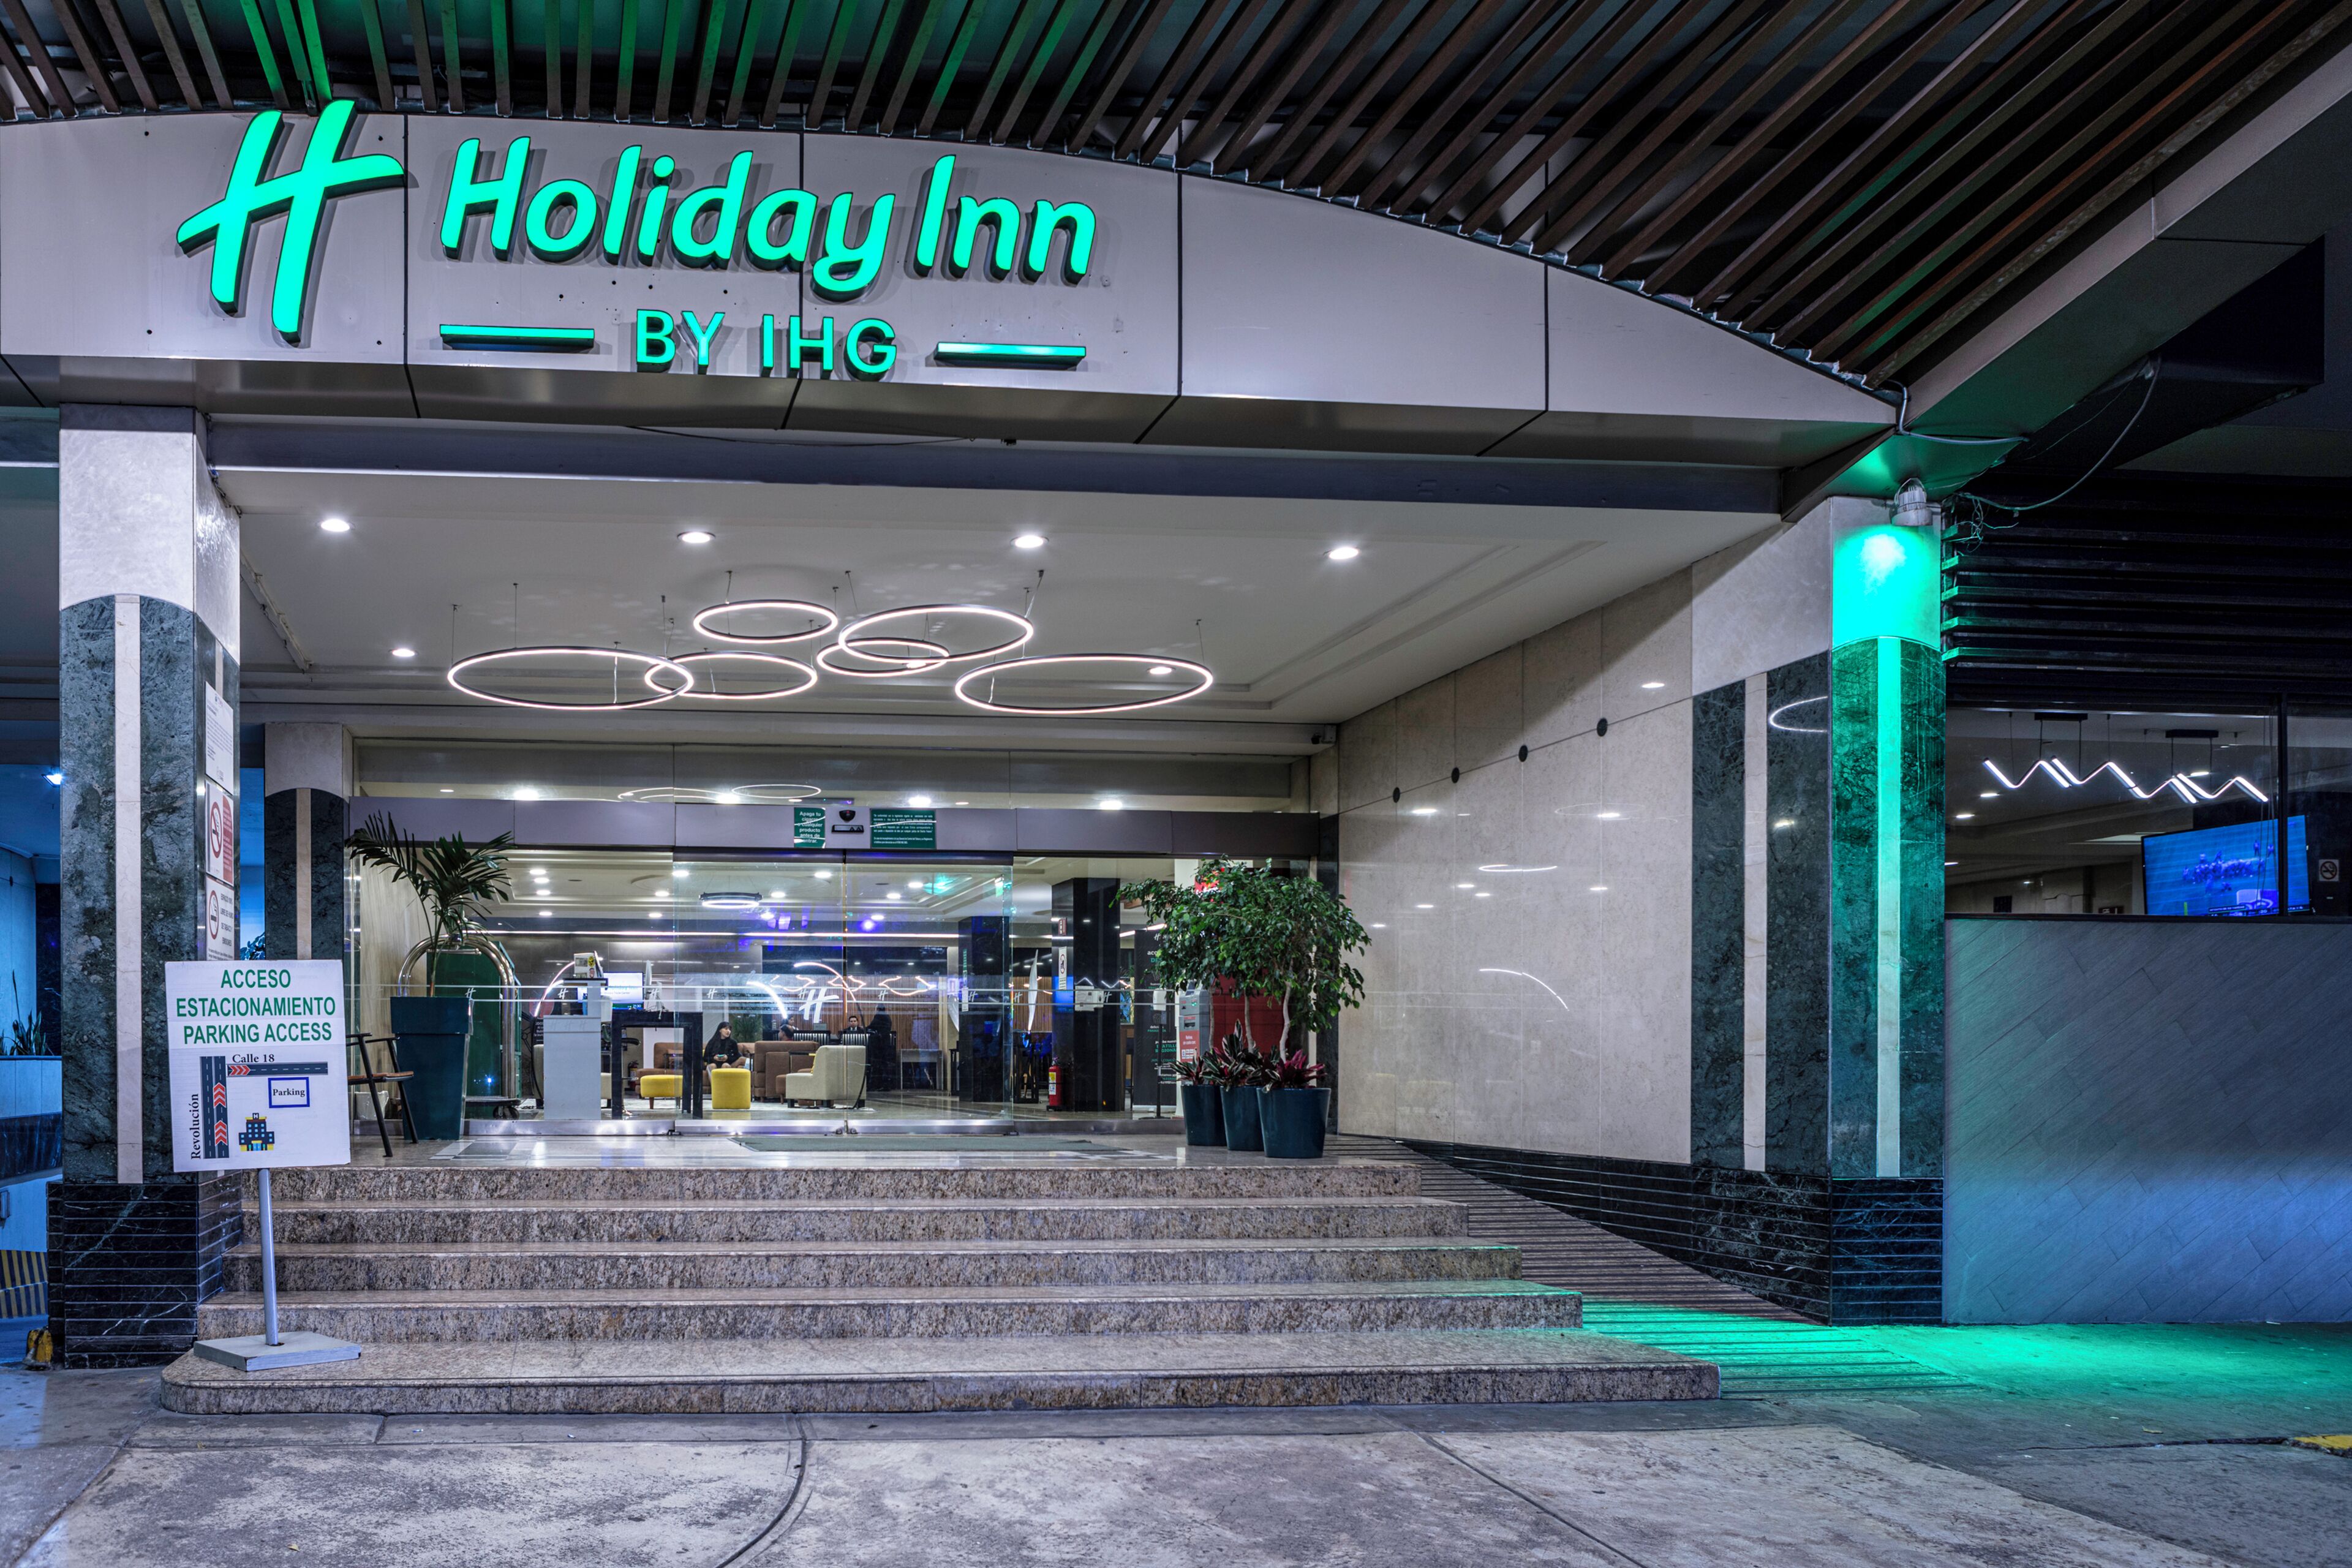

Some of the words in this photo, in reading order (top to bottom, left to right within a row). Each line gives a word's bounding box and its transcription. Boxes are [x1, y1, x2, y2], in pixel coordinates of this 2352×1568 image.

[440, 137, 895, 293] Holiday
[917, 156, 1096, 275] Inn
[636, 309, 725, 366] BY
[763, 314, 897, 375] IHG
[221, 970, 291, 989] ACCESO
[176, 997, 336, 1017] ESTACIONAMIENTO
[183, 1024, 259, 1044] PARKING
[264, 1022, 332, 1042] ACCESS
[232, 1054, 258, 1063] Calle
[273, 1088, 306, 1097] Parking
[189, 1093, 201, 1159] Revolución
